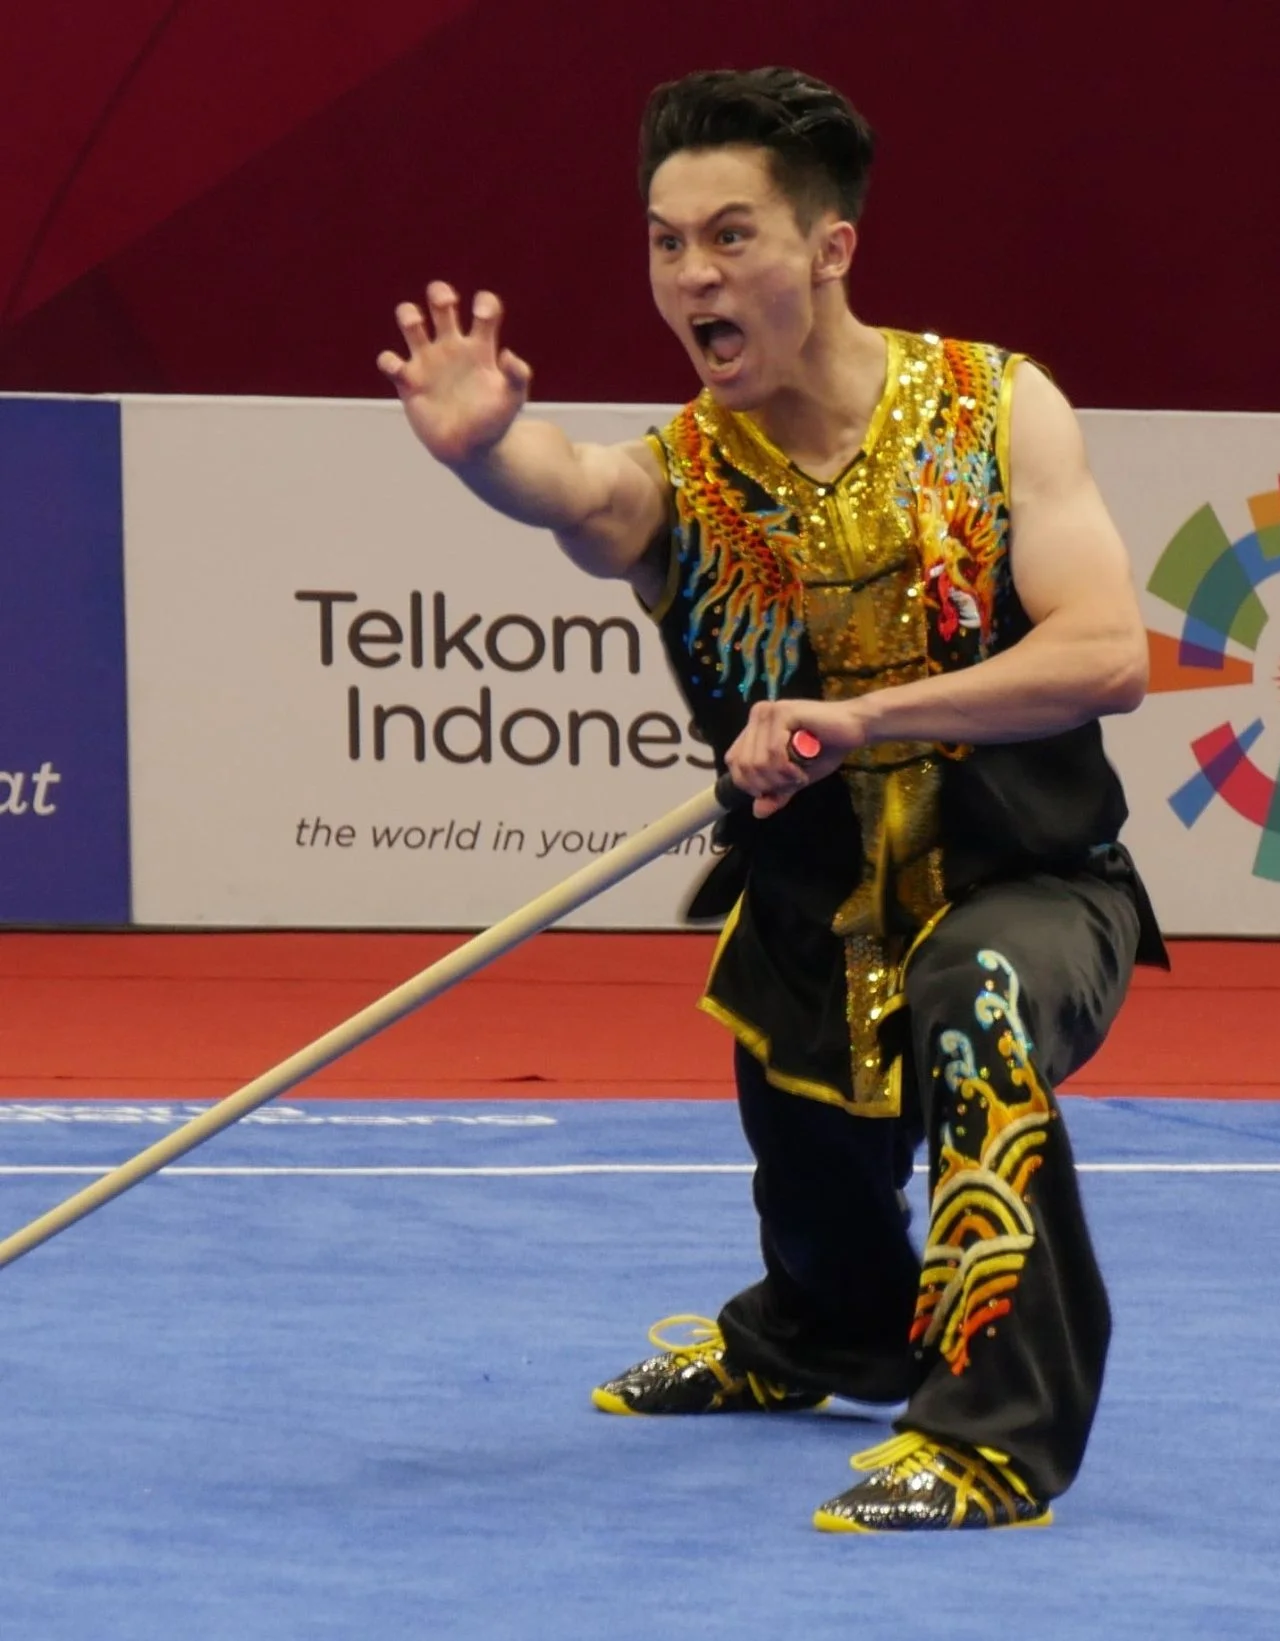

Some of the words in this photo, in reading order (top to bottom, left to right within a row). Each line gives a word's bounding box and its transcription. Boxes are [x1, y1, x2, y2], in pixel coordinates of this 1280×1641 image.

[294, 590, 641, 674] Telkom
[295, 817, 357, 848] the
[372, 820, 481, 851] world
[493, 822, 525, 852] in
[536, 829, 627, 858] your
